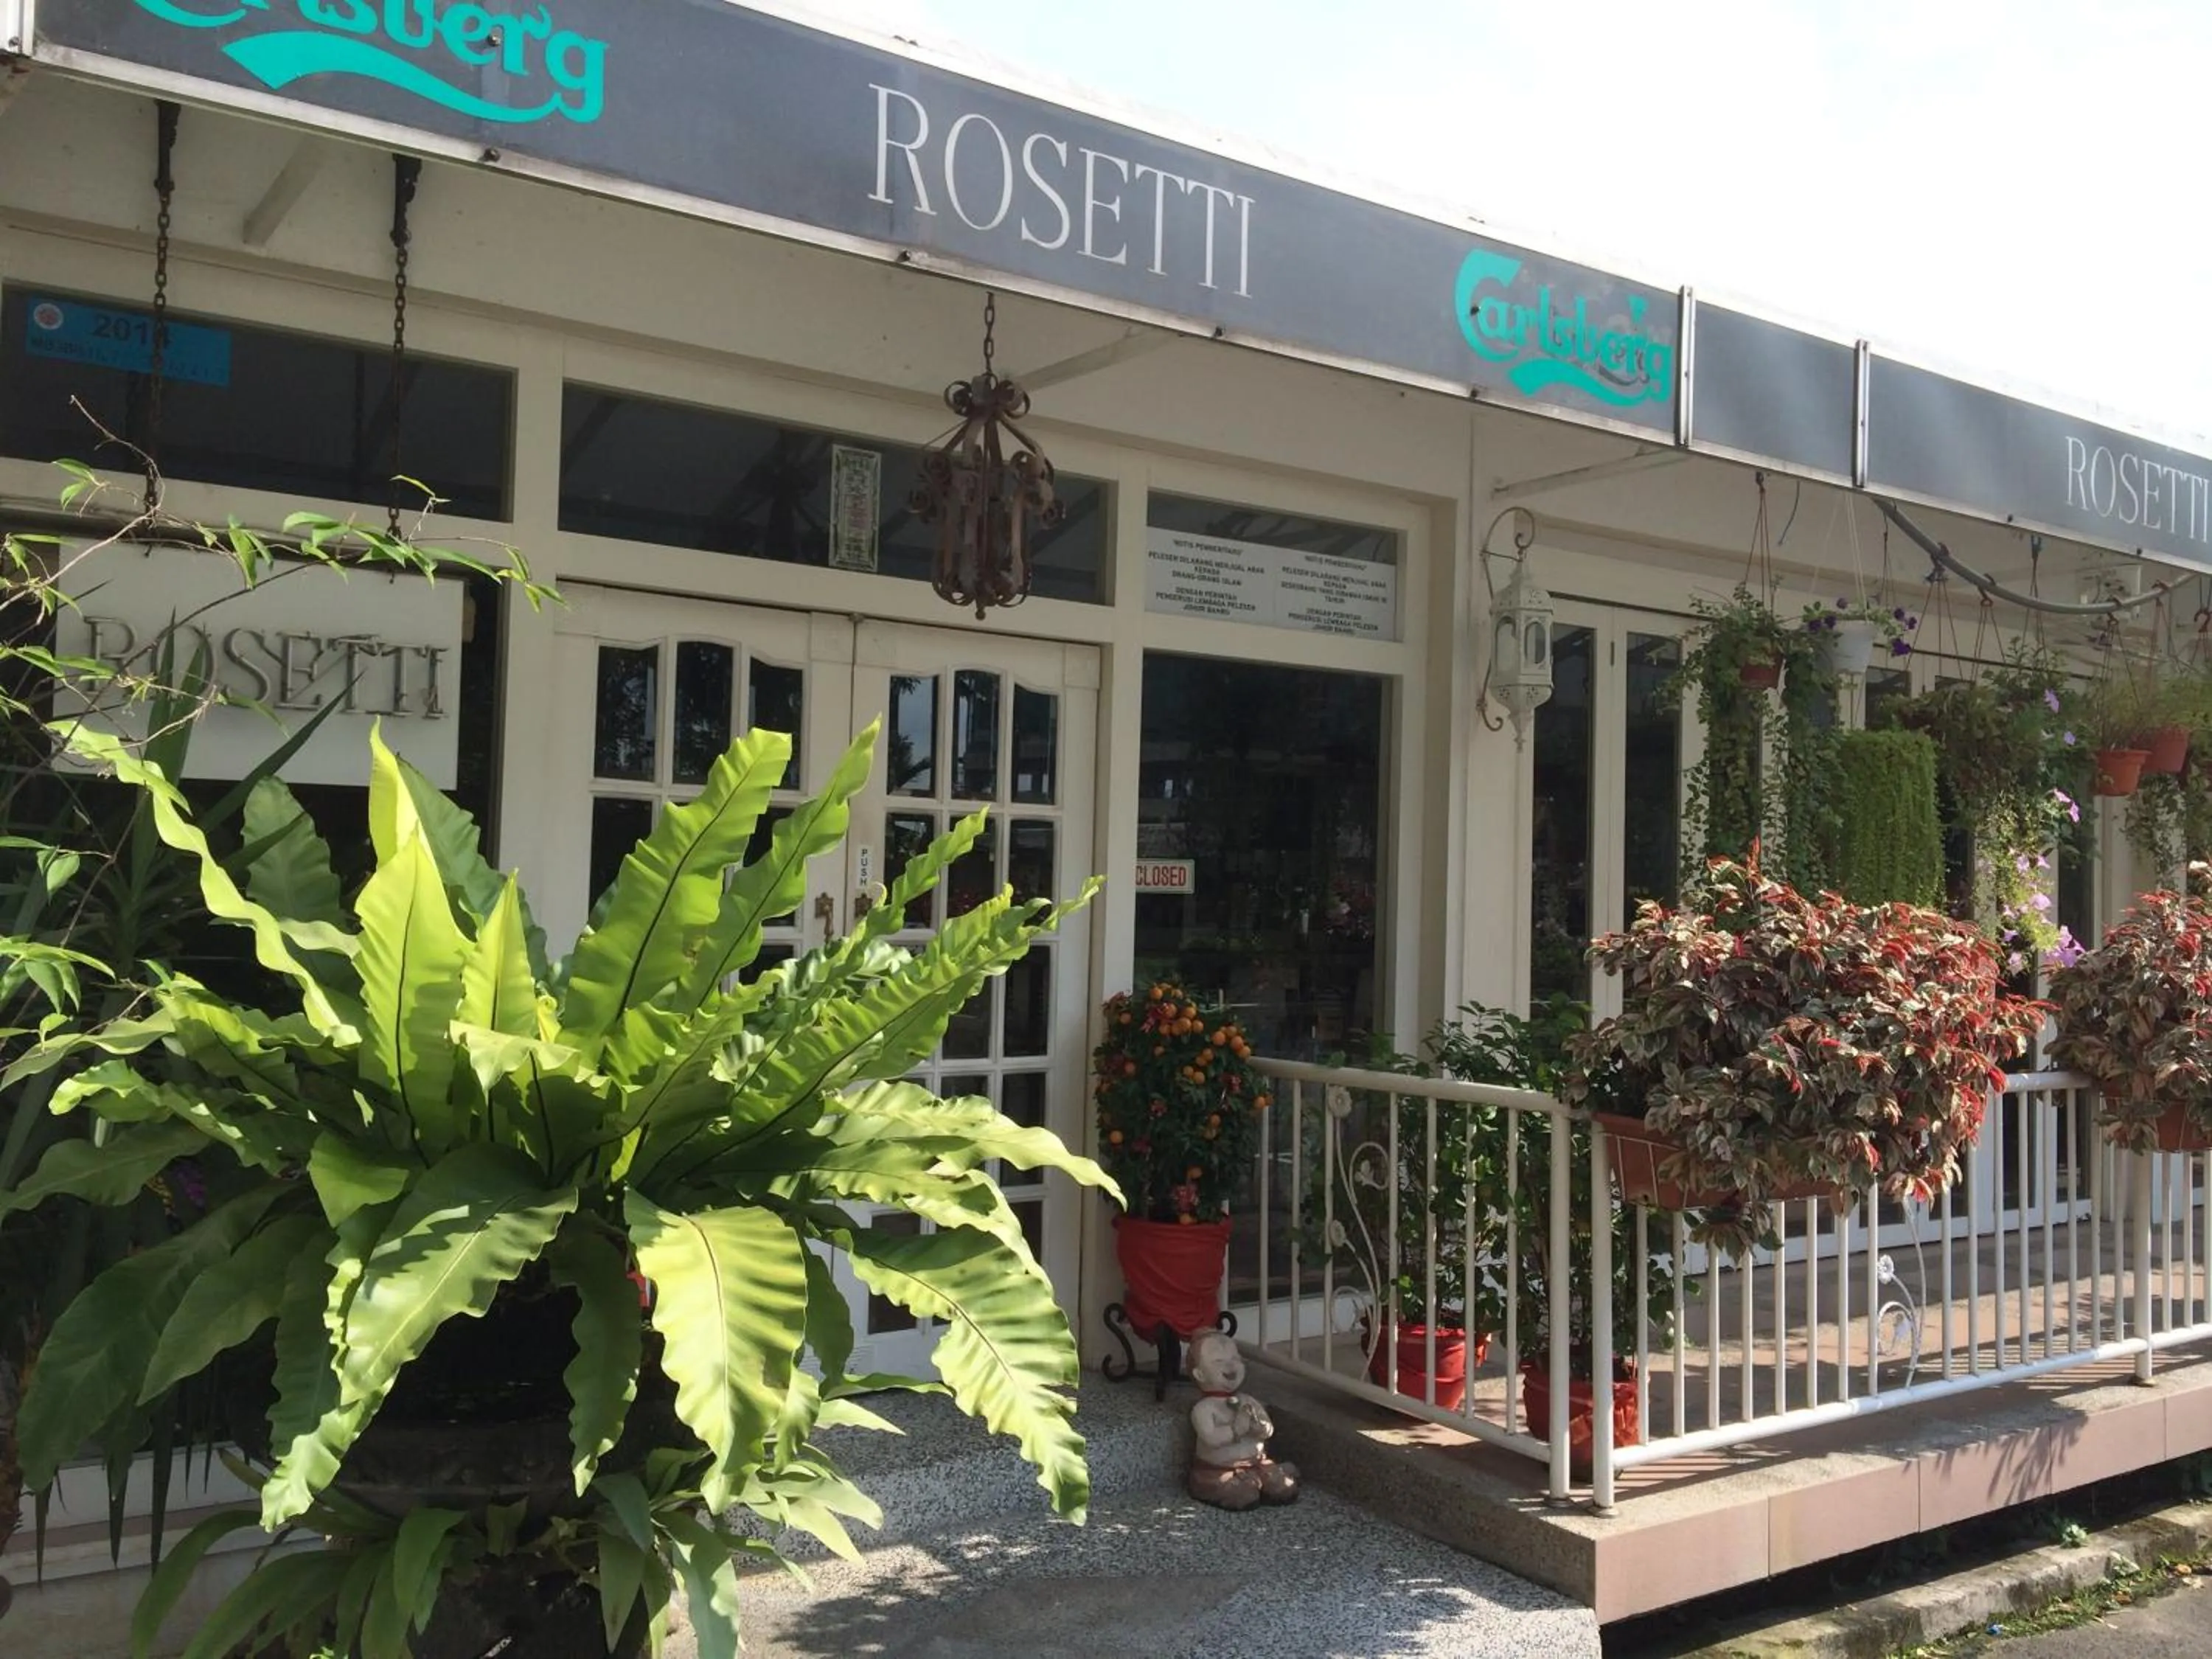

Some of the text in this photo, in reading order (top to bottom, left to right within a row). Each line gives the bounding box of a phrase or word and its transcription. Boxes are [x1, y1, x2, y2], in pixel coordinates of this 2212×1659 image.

[868, 83, 1256, 298] ROSETTI
[1454, 248, 1674, 407] Carlsberg
[2065, 434, 2211, 543] ROSETTI
[83, 615, 450, 720] ROSETTI
[859, 849, 868, 886] PUSH
[1135, 865, 1186, 886] CLOSED
